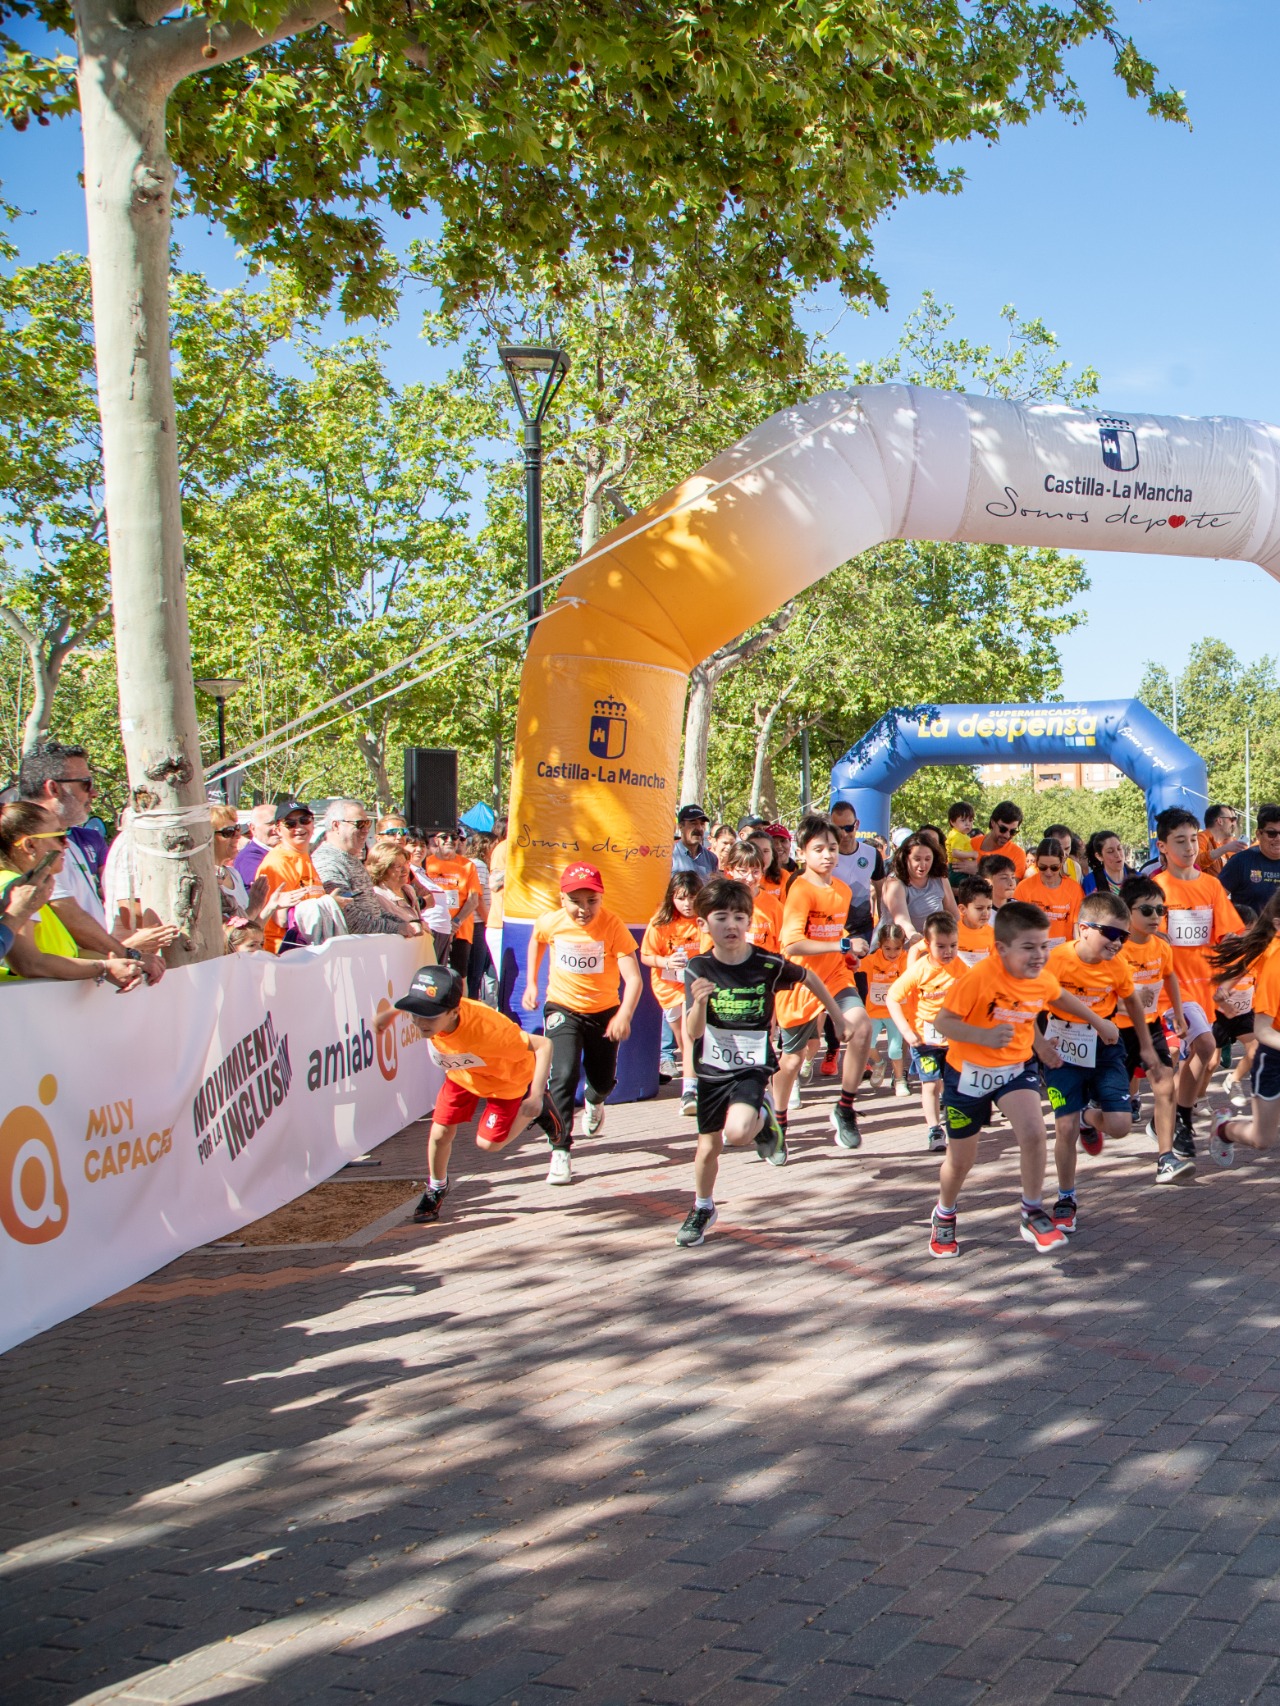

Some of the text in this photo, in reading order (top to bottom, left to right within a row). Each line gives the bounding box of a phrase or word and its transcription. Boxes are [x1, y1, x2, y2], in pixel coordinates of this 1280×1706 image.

[1134, 482, 1193, 503] Mancha
[986, 486, 1089, 523] Somos
[988, 709, 1088, 718] SUPERMERCADOS
[917, 713, 1098, 743] La despensa
[619, 768, 666, 789] Mancha
[517, 824, 579, 851] Somos
[569, 867, 595, 877] MAROC
[1176, 926, 1208, 939] 1088
[560, 954, 597, 969] 4060
[307, 1018, 374, 1091] amiab
[712, 1045, 756, 1066] 5065
[85, 1098, 134, 1141] MUY
[198, 1132, 213, 1165] POR
[213, 1122, 223, 1147] LA
